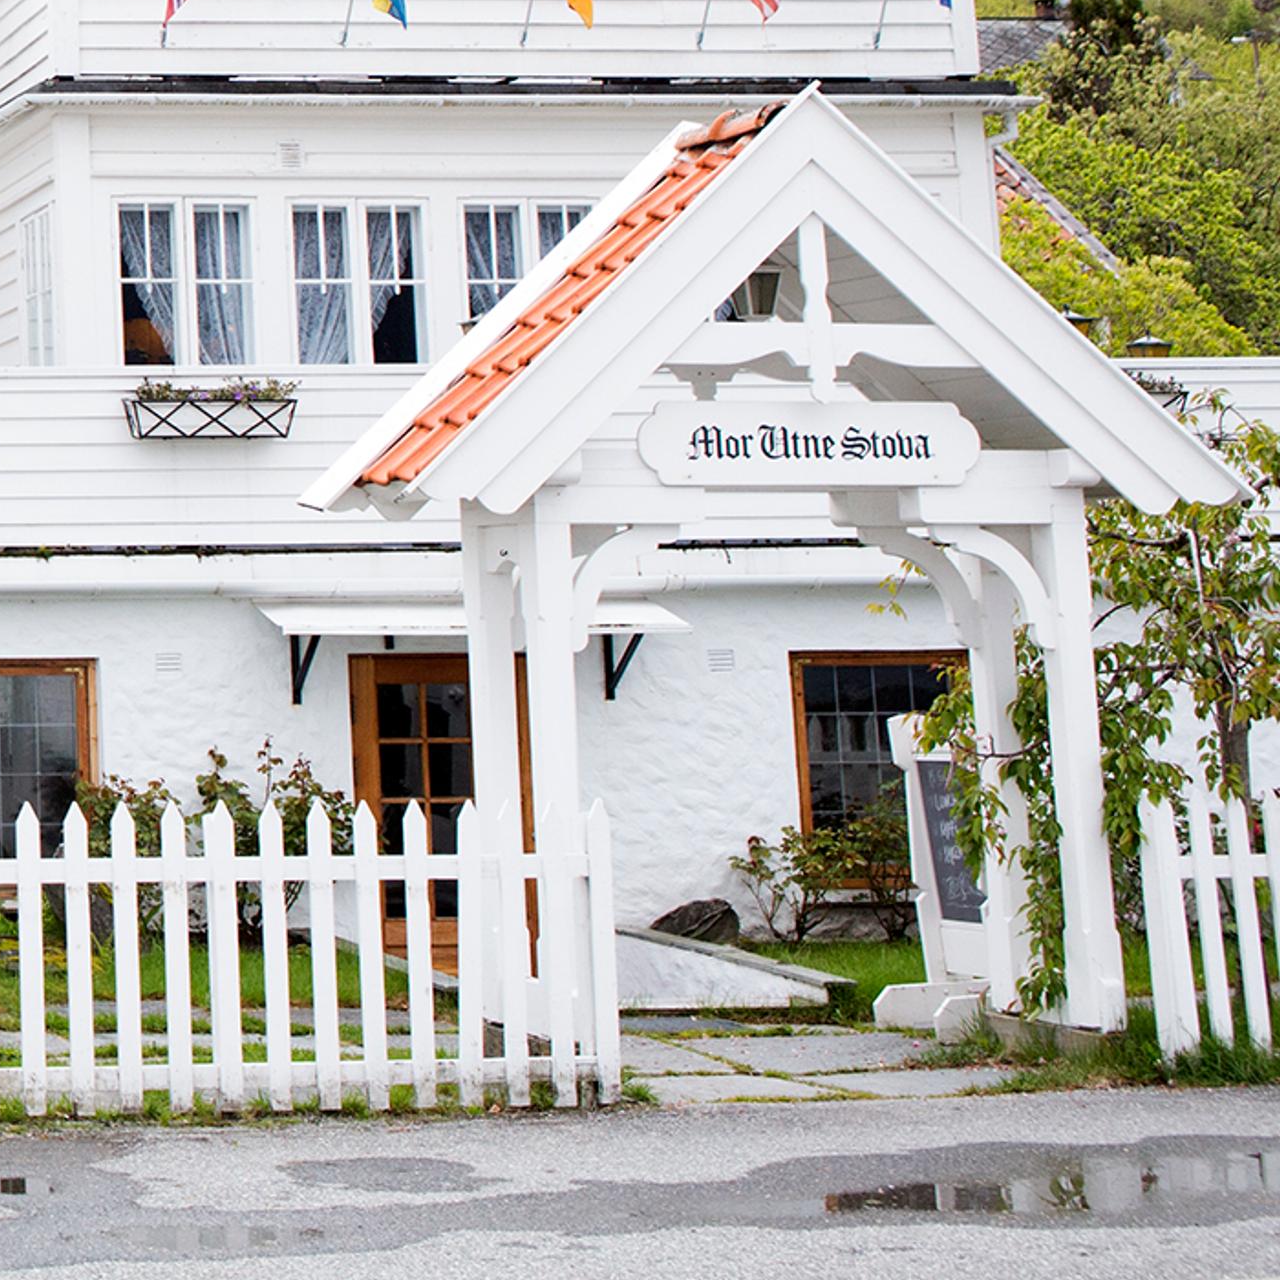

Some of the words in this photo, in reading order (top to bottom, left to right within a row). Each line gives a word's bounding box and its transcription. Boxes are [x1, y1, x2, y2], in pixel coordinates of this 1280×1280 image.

[688, 425, 753, 460] Mor
[757, 424, 836, 460] Utne
[840, 426, 932, 461] Stova
